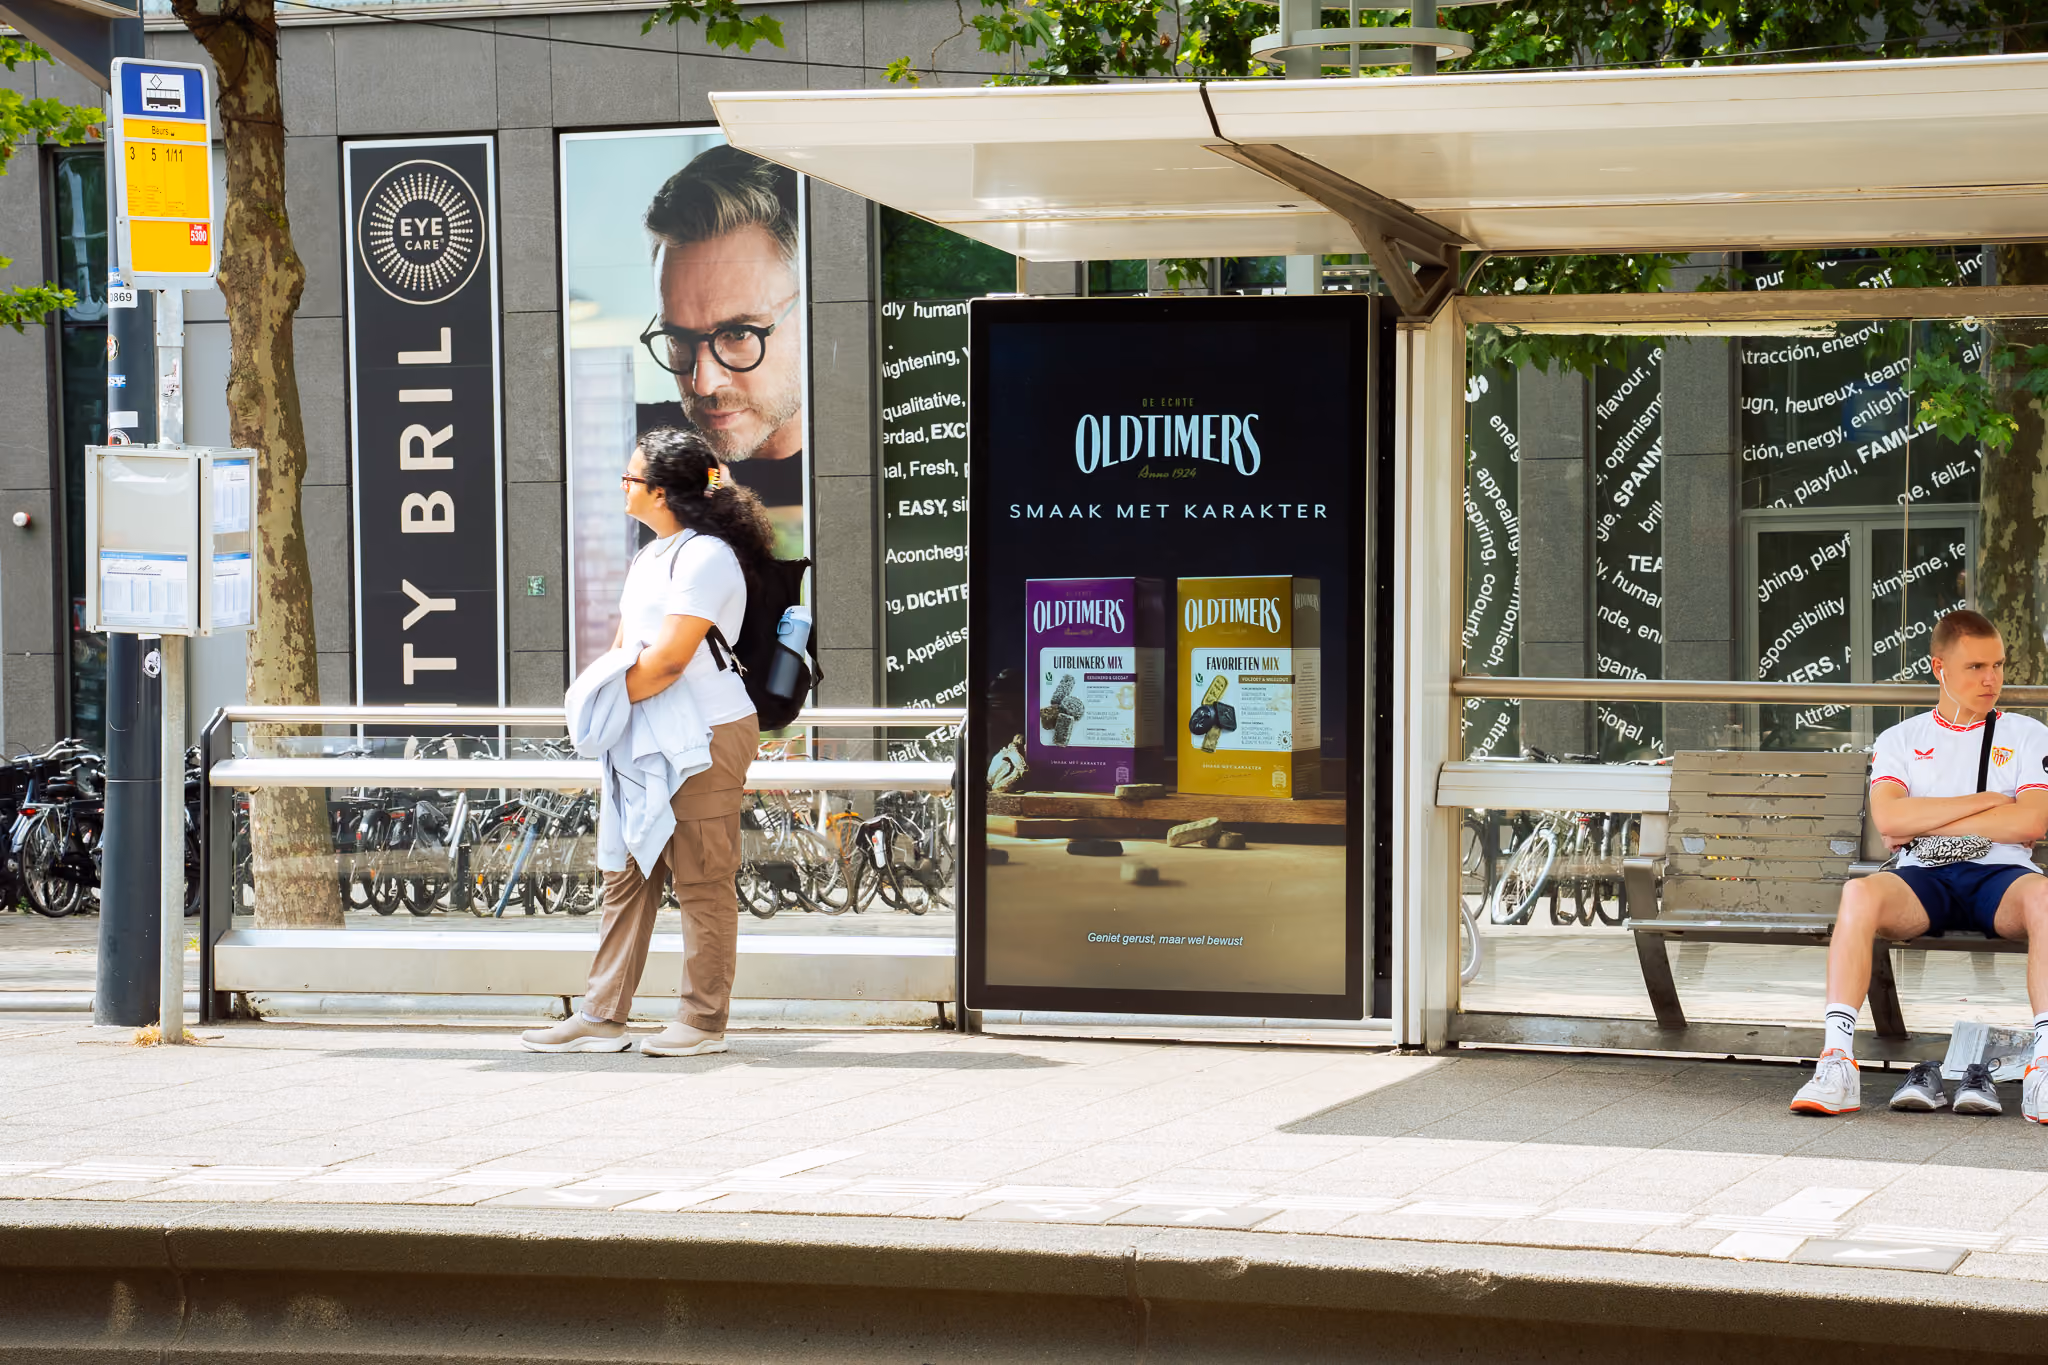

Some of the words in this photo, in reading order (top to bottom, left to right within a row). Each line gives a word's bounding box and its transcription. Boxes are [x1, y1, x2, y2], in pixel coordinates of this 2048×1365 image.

[151, 125, 168, 136] Beurs
[130, 146, 136, 160] 3
[151, 148, 157, 161] 5
[166, 148, 183, 162] 1/11
[190, 230, 207, 241] 5300
[400, 217, 443, 237] EYE
[882, 350, 961, 379] lightening,
[1596, 366, 1652, 420] flavour,
[1785, 380, 1863, 414] heureux,
[882, 391, 967, 422] qualitative,
[397, 326, 456, 534] BRIL
[1786, 425, 1848, 456] energy,
[1075, 413, 1261, 476] OLDTIMERS
[909, 458, 959, 479] Fresh,
[1138, 464, 1169, 479] Anno
[1172, 467, 1197, 480] 1924
[1931, 459, 1976, 490] feliz,
[1794, 458, 1859, 505] playful,
[898, 499, 948, 518] EASY,
[952, 496, 969, 513] si
[1009, 504, 1103, 519] SMAAK
[1116, 504, 1170, 519] MET
[1184, 504, 1328, 519] KARAKTER
[1033, 599, 1125, 634] OLDTIMERS
[1184, 597, 1281, 634] OLDTIMERS
[1053, 656, 1105, 670] UITBLINKERS
[1107, 656, 1123, 669] MIX
[1206, 656, 1260, 671] FAVORIETEN
[1262, 656, 1279, 671] MIX
[1087, 932, 1121, 943] Geniet
[1122, 934, 1156, 946] gerust,
[1158, 936, 1186, 945] maar
[1187, 936, 1204, 945] wel
[1207, 935, 1243, 946] bewust
